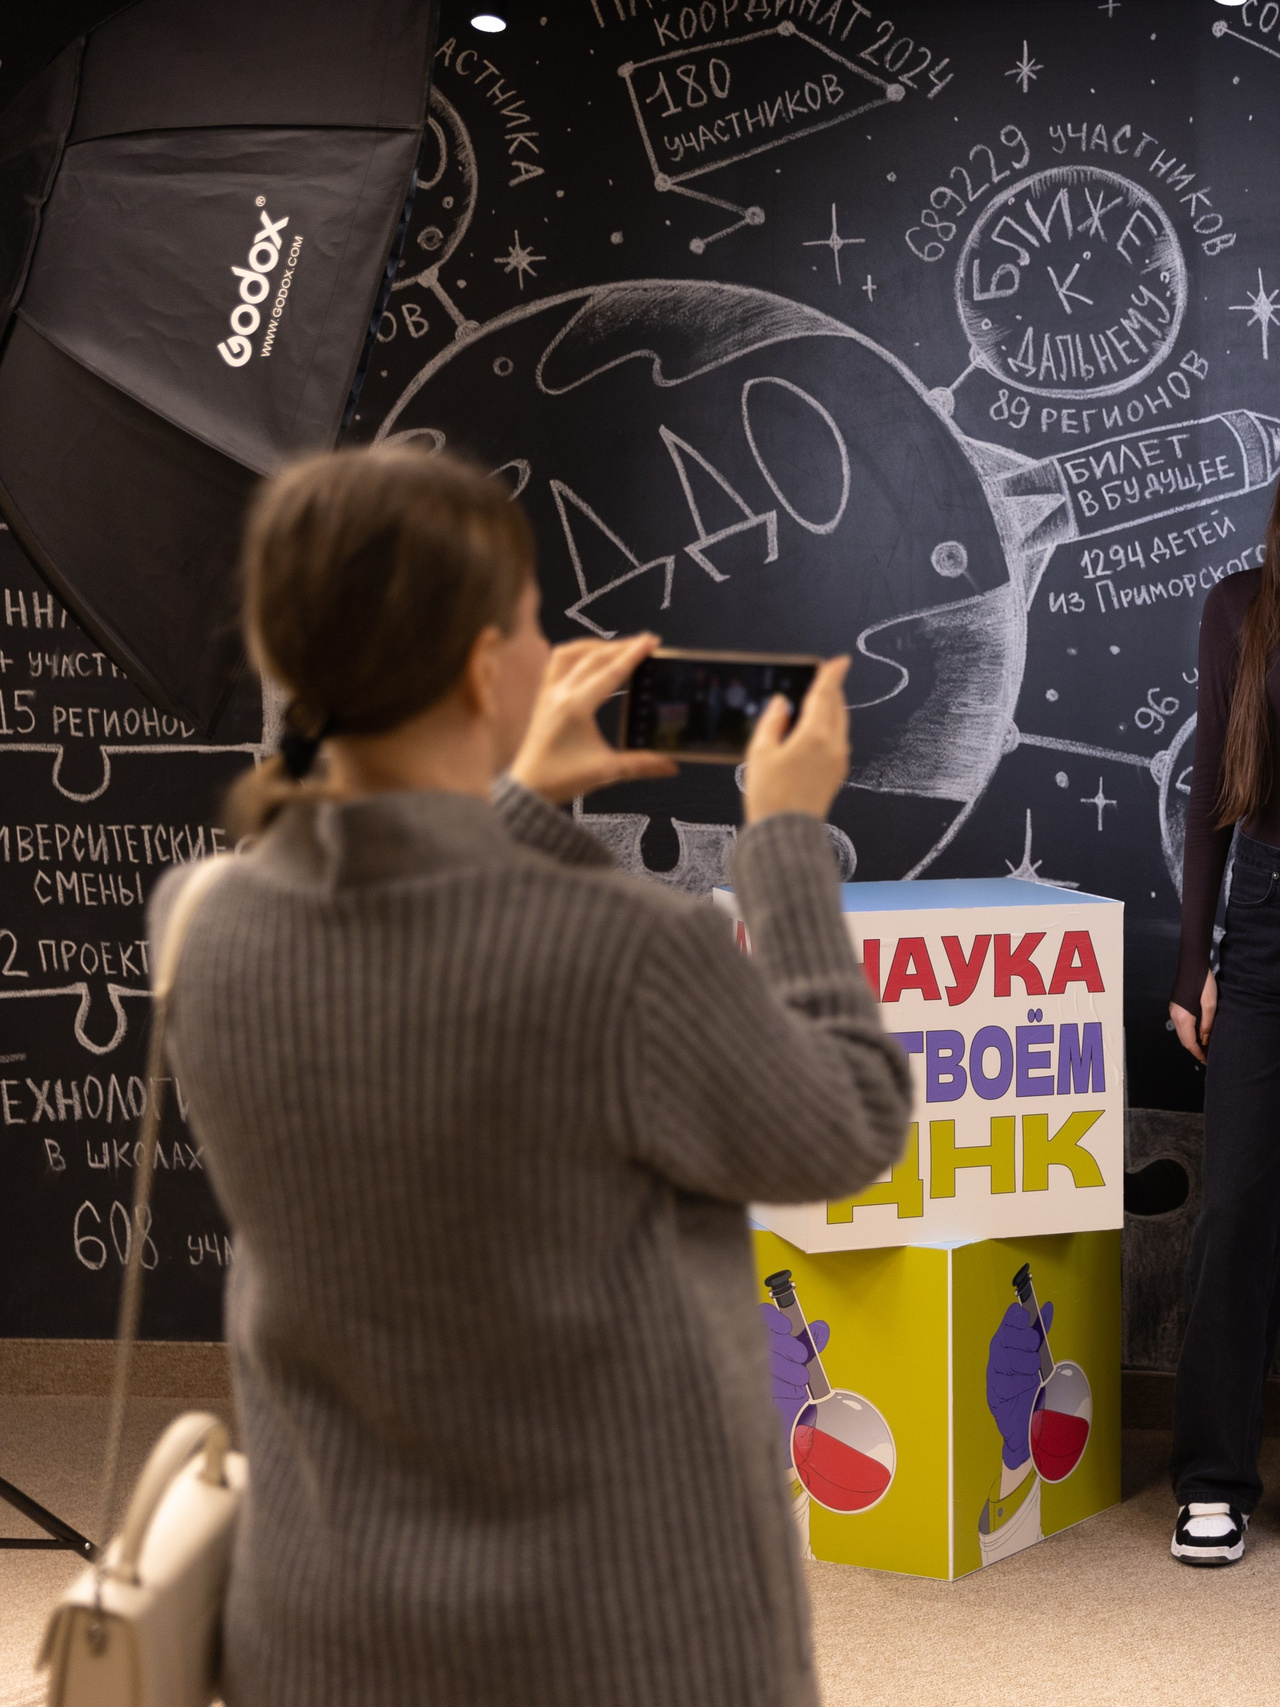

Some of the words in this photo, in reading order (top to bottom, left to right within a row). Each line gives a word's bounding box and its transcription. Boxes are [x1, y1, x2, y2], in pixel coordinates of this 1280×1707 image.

[646, 58, 731, 118] 180
[858, 20, 954, 99] 2024
[663, 74, 845, 162] УЧАСТНИКОВ
[905, 125, 1030, 262] 689229
[1050, 122, 1237, 256] УЧАСТНИКОВ
[973, 187, 1158, 301] БЛИЖЕ
[217, 203, 290, 368] Godox
[260, 235, 304, 358] WWW.GODOX.COM
[1047, 263, 1093, 314] К
[1008, 285, 1170, 382] ДАЛЬНЕМУ
[989, 389, 1030, 429] 89
[1041, 350, 1209, 434] РЕГИОНОВ
[1064, 434, 1190, 484] БИЛЕТ
[1077, 490, 1099, 517] В
[1101, 455, 1235, 511] БУДУЩЕЕ
[1080, 541, 1146, 579] 1294
[1150, 510, 1236, 563] ДЕТЕЙ
[1134, 688, 1180, 735] 96
[33, 869, 145, 906] СМЕНЫ
[44, 1138, 66, 1171] В
[827, 1110, 1106, 1225] ДНК
[73, 1200, 158, 1270] 608
